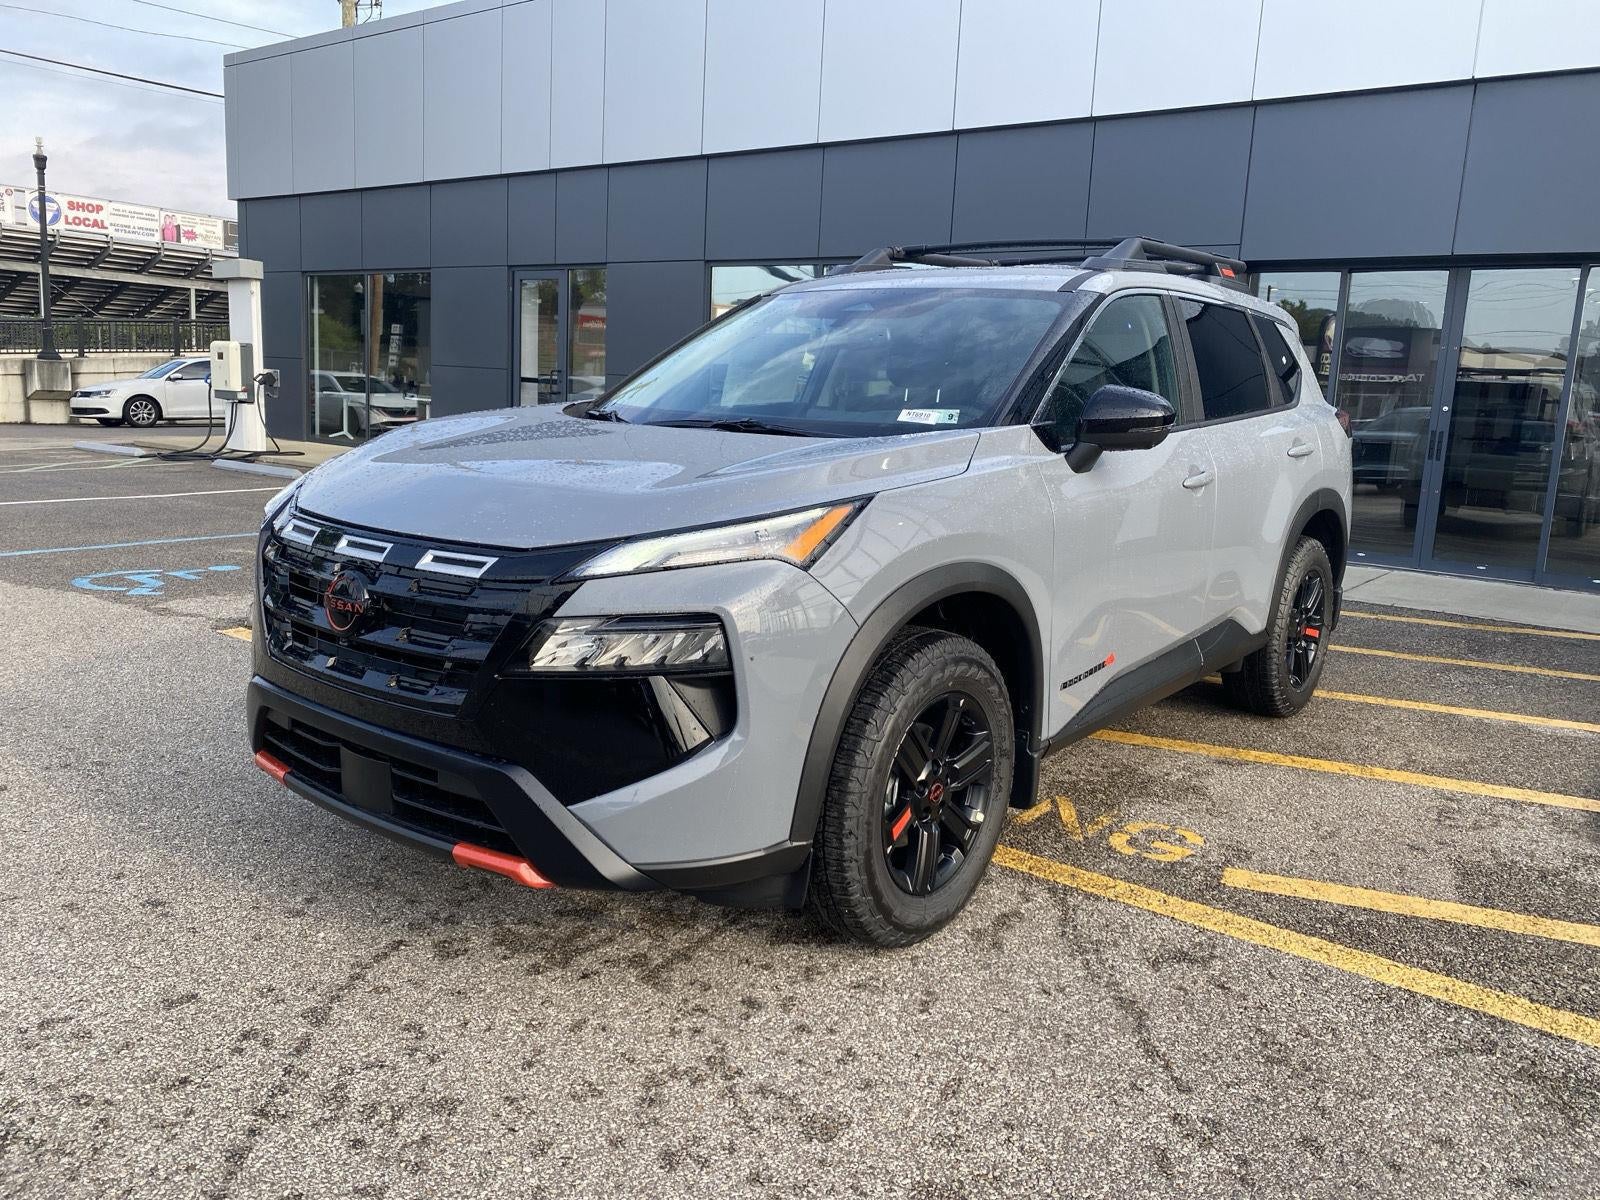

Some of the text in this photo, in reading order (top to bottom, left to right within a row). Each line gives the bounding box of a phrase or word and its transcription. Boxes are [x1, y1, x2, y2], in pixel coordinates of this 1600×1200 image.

[67, 200, 104, 214] SHOP
[64, 215, 109, 230] LOCAL
[325, 594, 365, 614] SSAN
